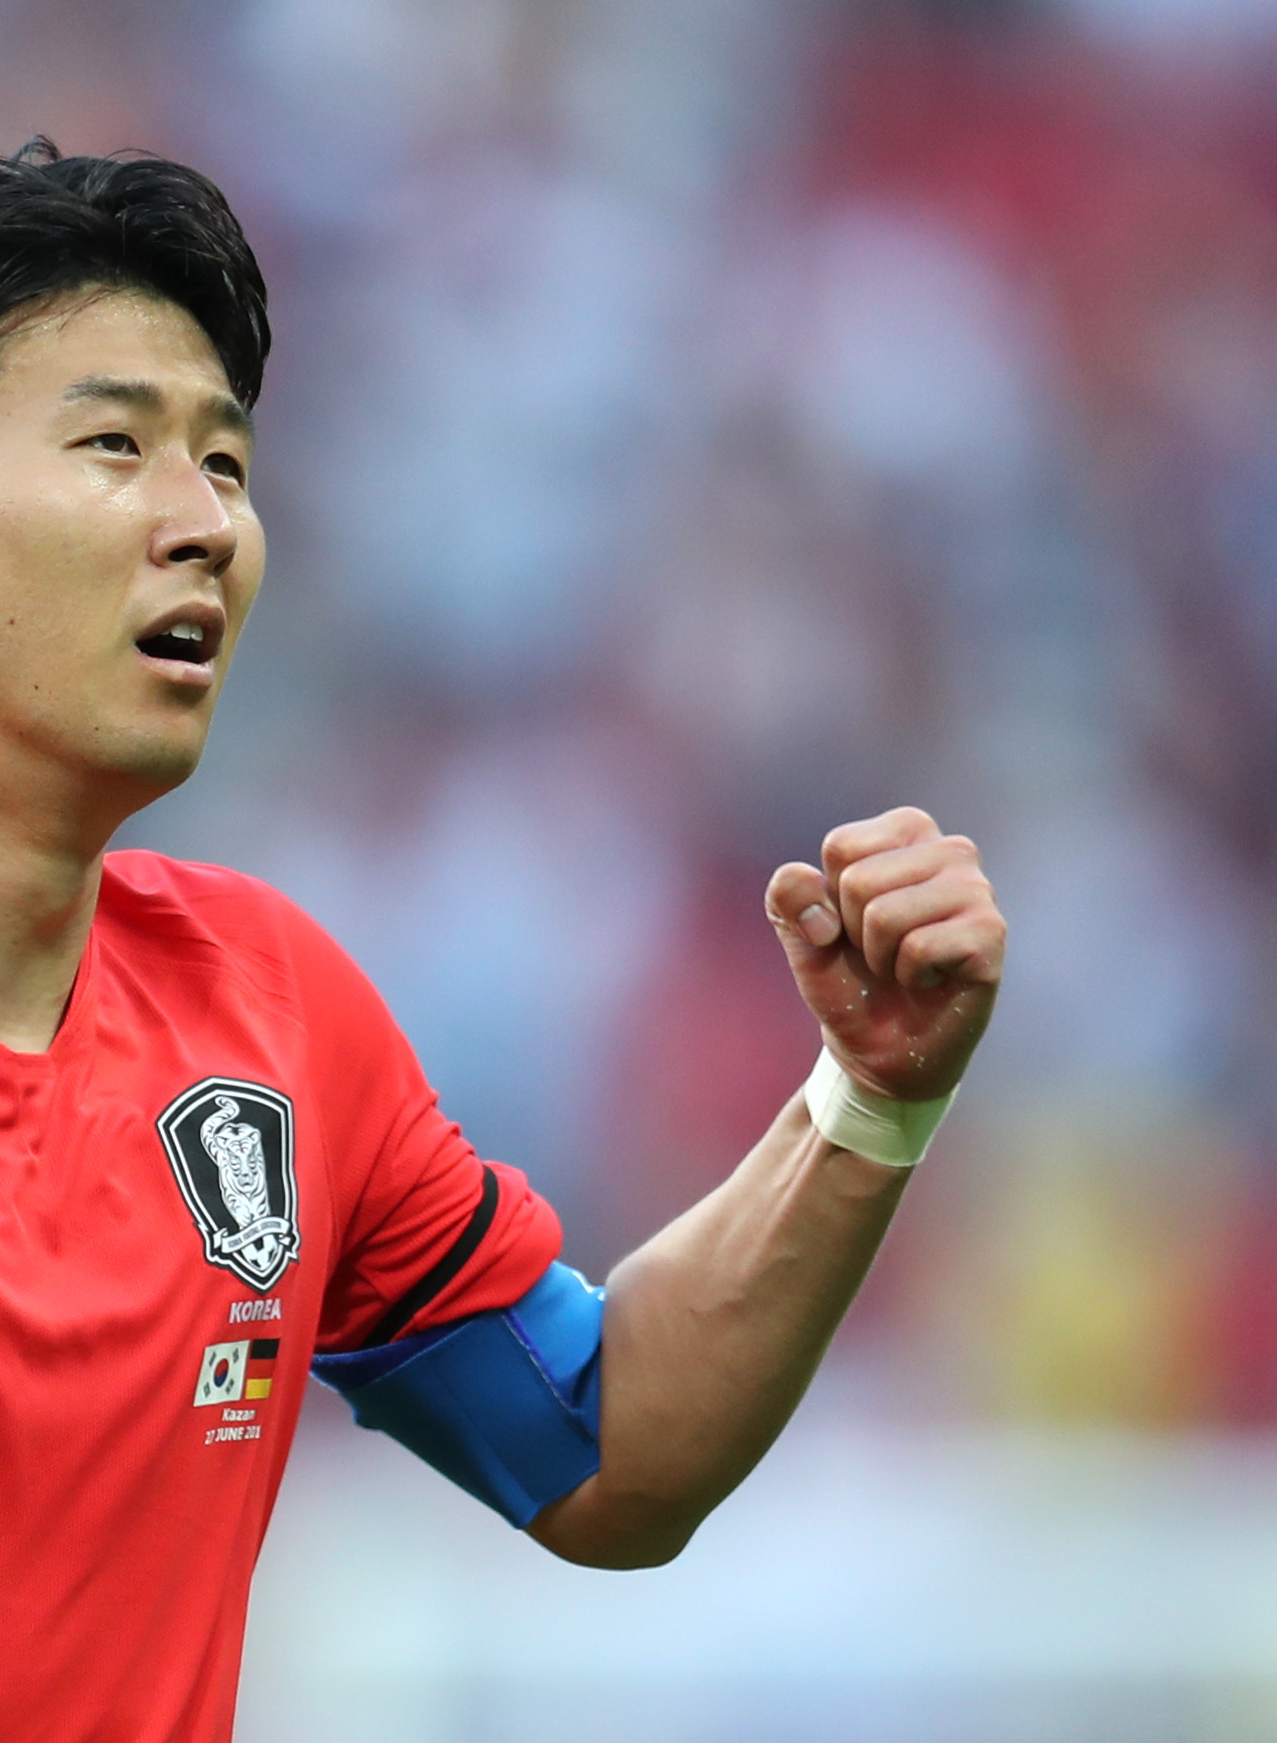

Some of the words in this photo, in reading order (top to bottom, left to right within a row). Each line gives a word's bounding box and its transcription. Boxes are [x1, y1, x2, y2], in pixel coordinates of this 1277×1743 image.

[229, 1299, 281, 1323] KOREA
[222, 1408, 256, 1421] Kazan
[215, 1427, 245, 1442] JUNE
[244, 1425, 261, 1439] 201
